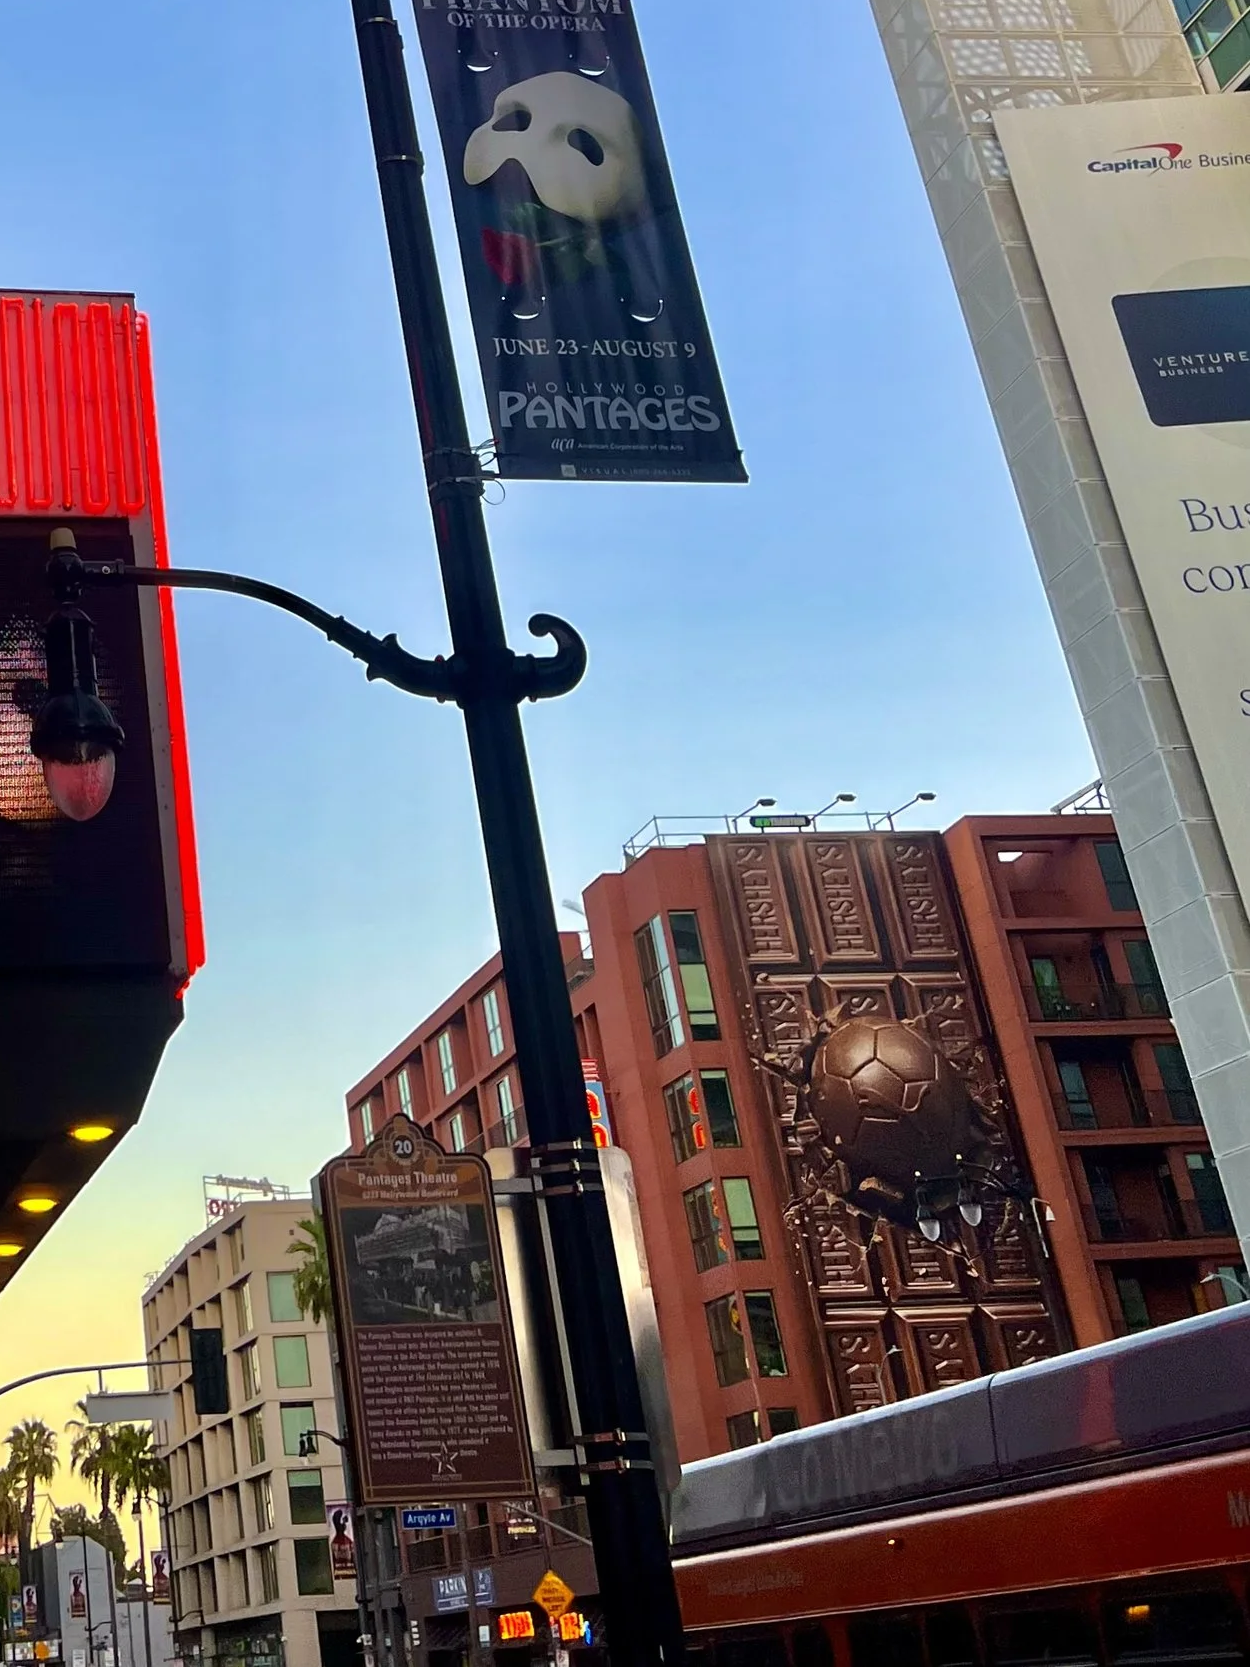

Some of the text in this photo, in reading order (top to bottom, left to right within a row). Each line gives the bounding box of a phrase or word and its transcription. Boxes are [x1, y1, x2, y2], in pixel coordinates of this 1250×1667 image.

[447, 11, 607, 32] OF THE OPERA
[492, 337, 550, 357] JUNE
[683, 342, 697, 359] 9
[1152, 351, 1250, 367] VENTURE
[1158, 365, 1224, 377] BUSINESS
[526, 381, 685, 397] HOLLYWOOD
[498, 390, 722, 433] PANTAGES
[394, 1140, 412, 1154] 20
[358, 1171, 458, 1188] Pantages Theatre
[407, 1512, 452, 1527] Argyle Av
